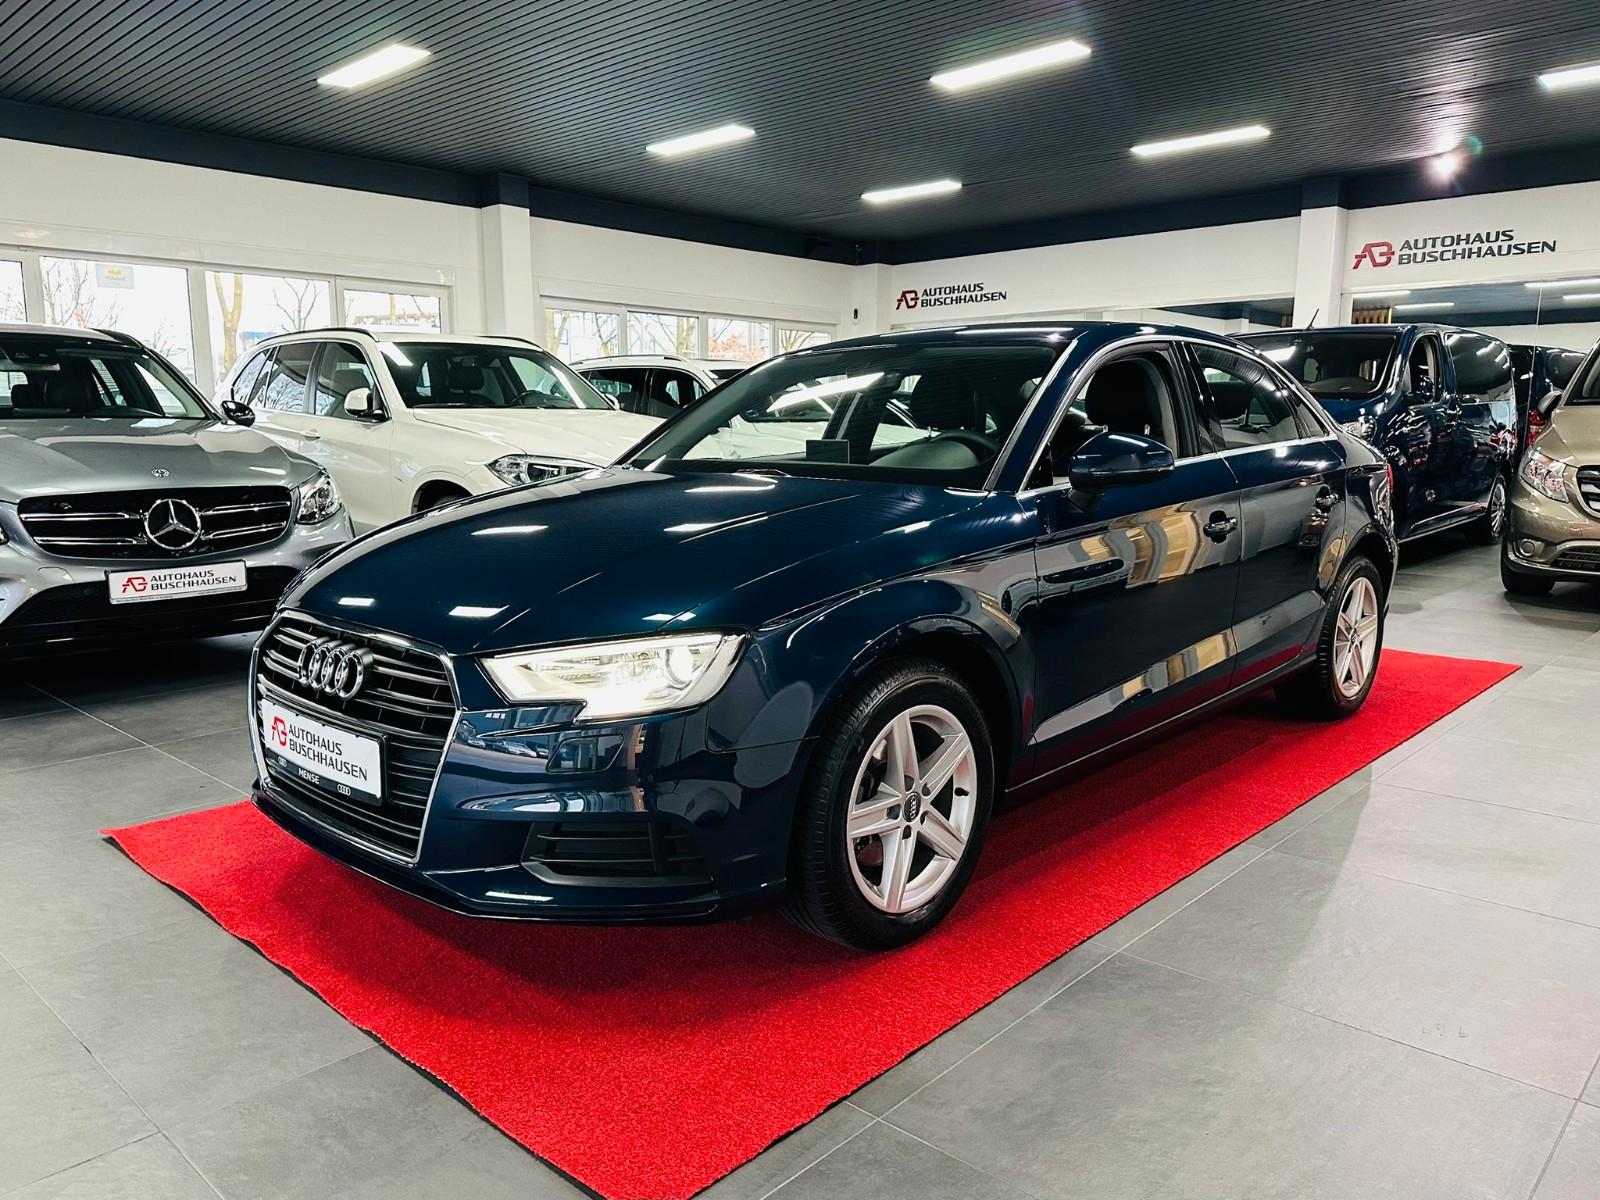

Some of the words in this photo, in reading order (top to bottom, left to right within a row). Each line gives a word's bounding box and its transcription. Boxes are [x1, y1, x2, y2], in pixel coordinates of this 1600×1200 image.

[1399, 229, 1514, 252] AUTOHAUS
[1398, 240, 1557, 265] BUSCHHAUSEN
[921, 282, 984, 298] AUTOHAUS
[920, 291, 1007, 308] BUSCHHAUSEN
[150, 569, 214, 583] AUTOHAUS
[151, 576, 237, 591] BUSCHHAUSEN
[288, 723, 343, 756] AUTOHAUS
[289, 738, 368, 781] BUSCHHAUSEN
[298, 767, 320, 785] MENSE
